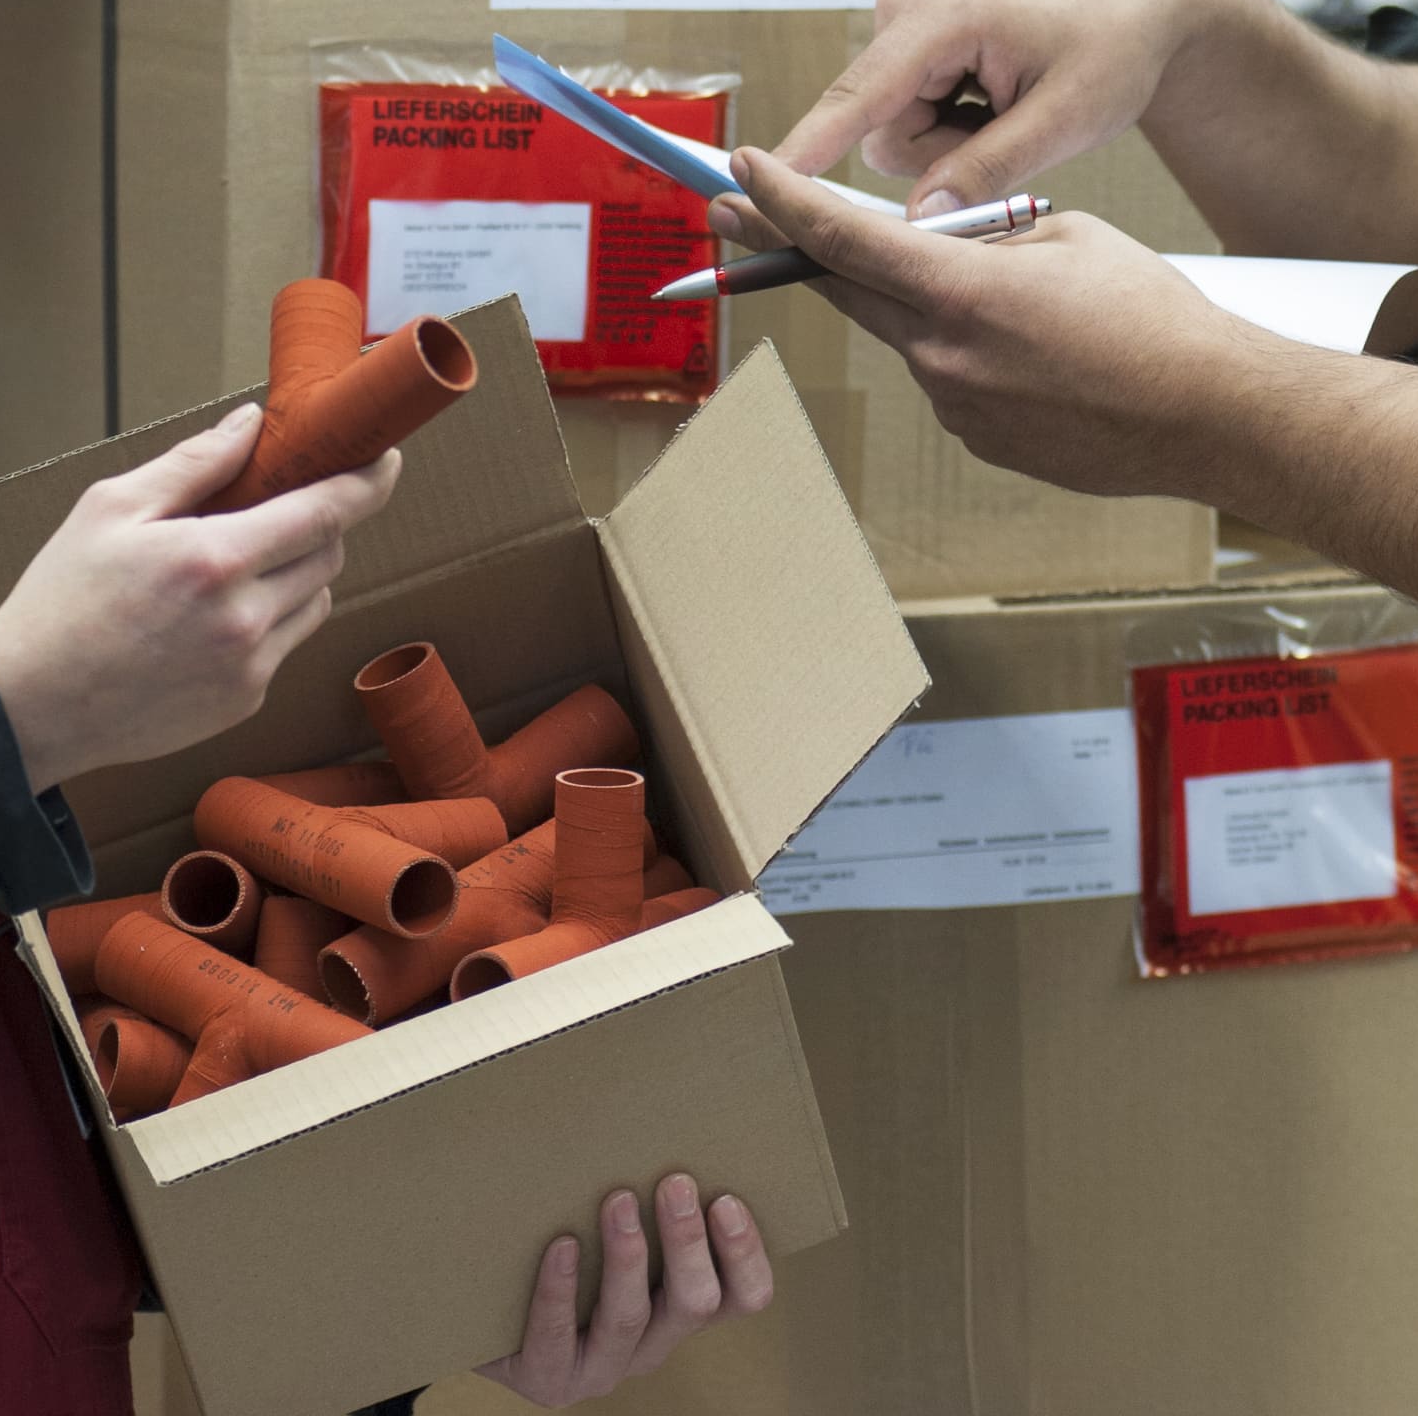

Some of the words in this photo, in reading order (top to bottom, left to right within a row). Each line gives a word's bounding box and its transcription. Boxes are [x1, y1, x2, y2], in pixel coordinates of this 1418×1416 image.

[373, 99, 543, 124] LIEFERSCHEIN
[373, 126, 477, 149] PACKING
[483, 129, 535, 151] LIST
[1181, 666, 1338, 697] LIEFERSCHEIN
[1183, 696, 1278, 722] PACKING
[1284, 691, 1332, 717] LIST
